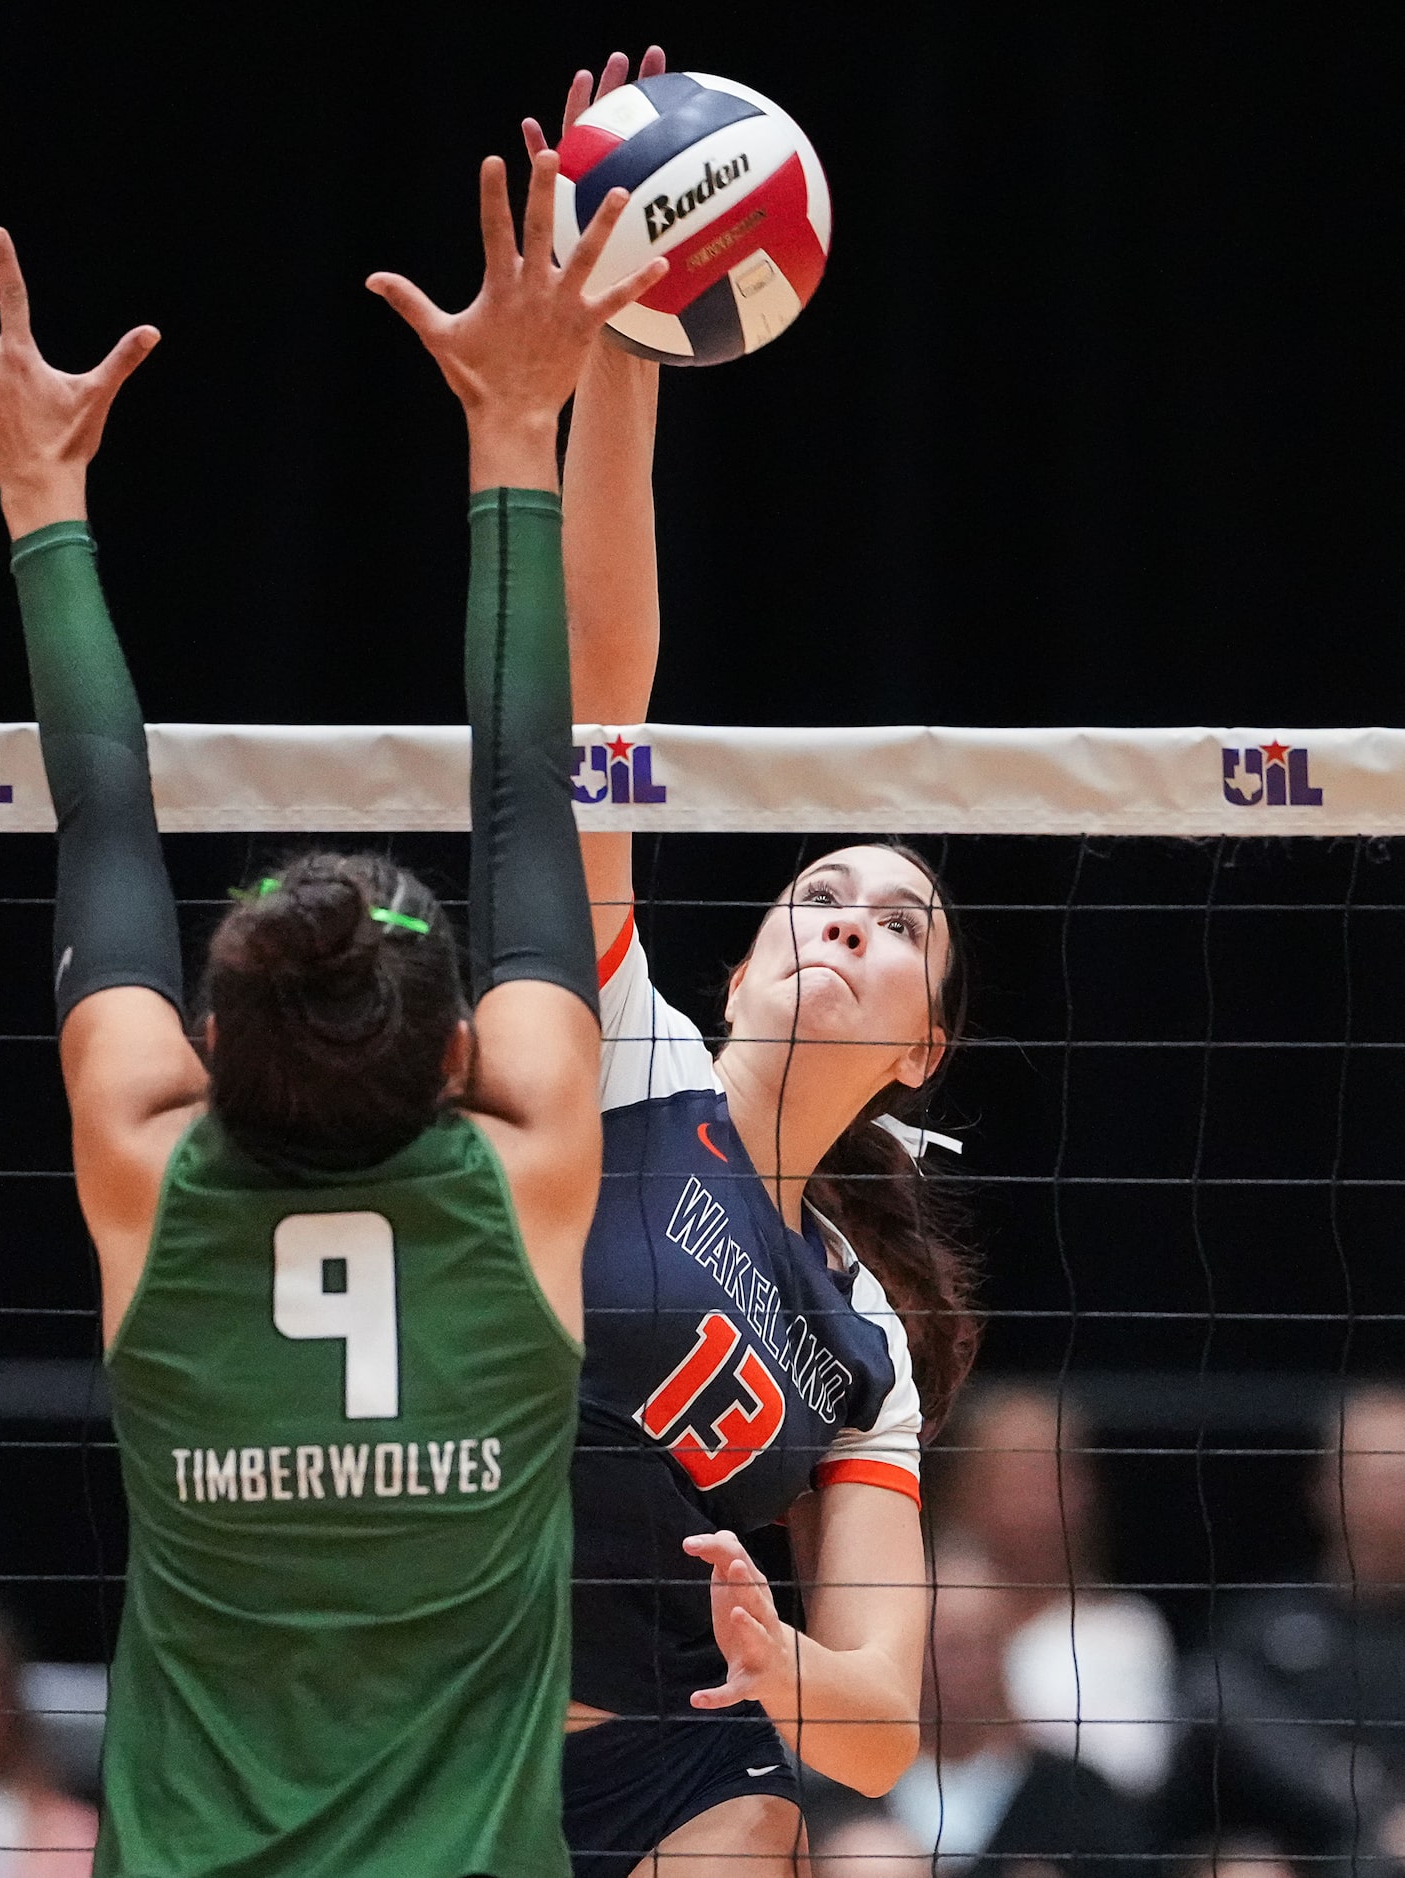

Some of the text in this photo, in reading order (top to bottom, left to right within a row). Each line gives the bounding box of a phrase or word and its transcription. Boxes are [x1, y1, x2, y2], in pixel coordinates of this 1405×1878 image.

[273, 1211, 399, 1419] 9
[666, 1174, 852, 1423] WAKELAND
[171, 1438, 502, 1502] TIMBERWOLVES
[632, 1309, 785, 1491] 13
